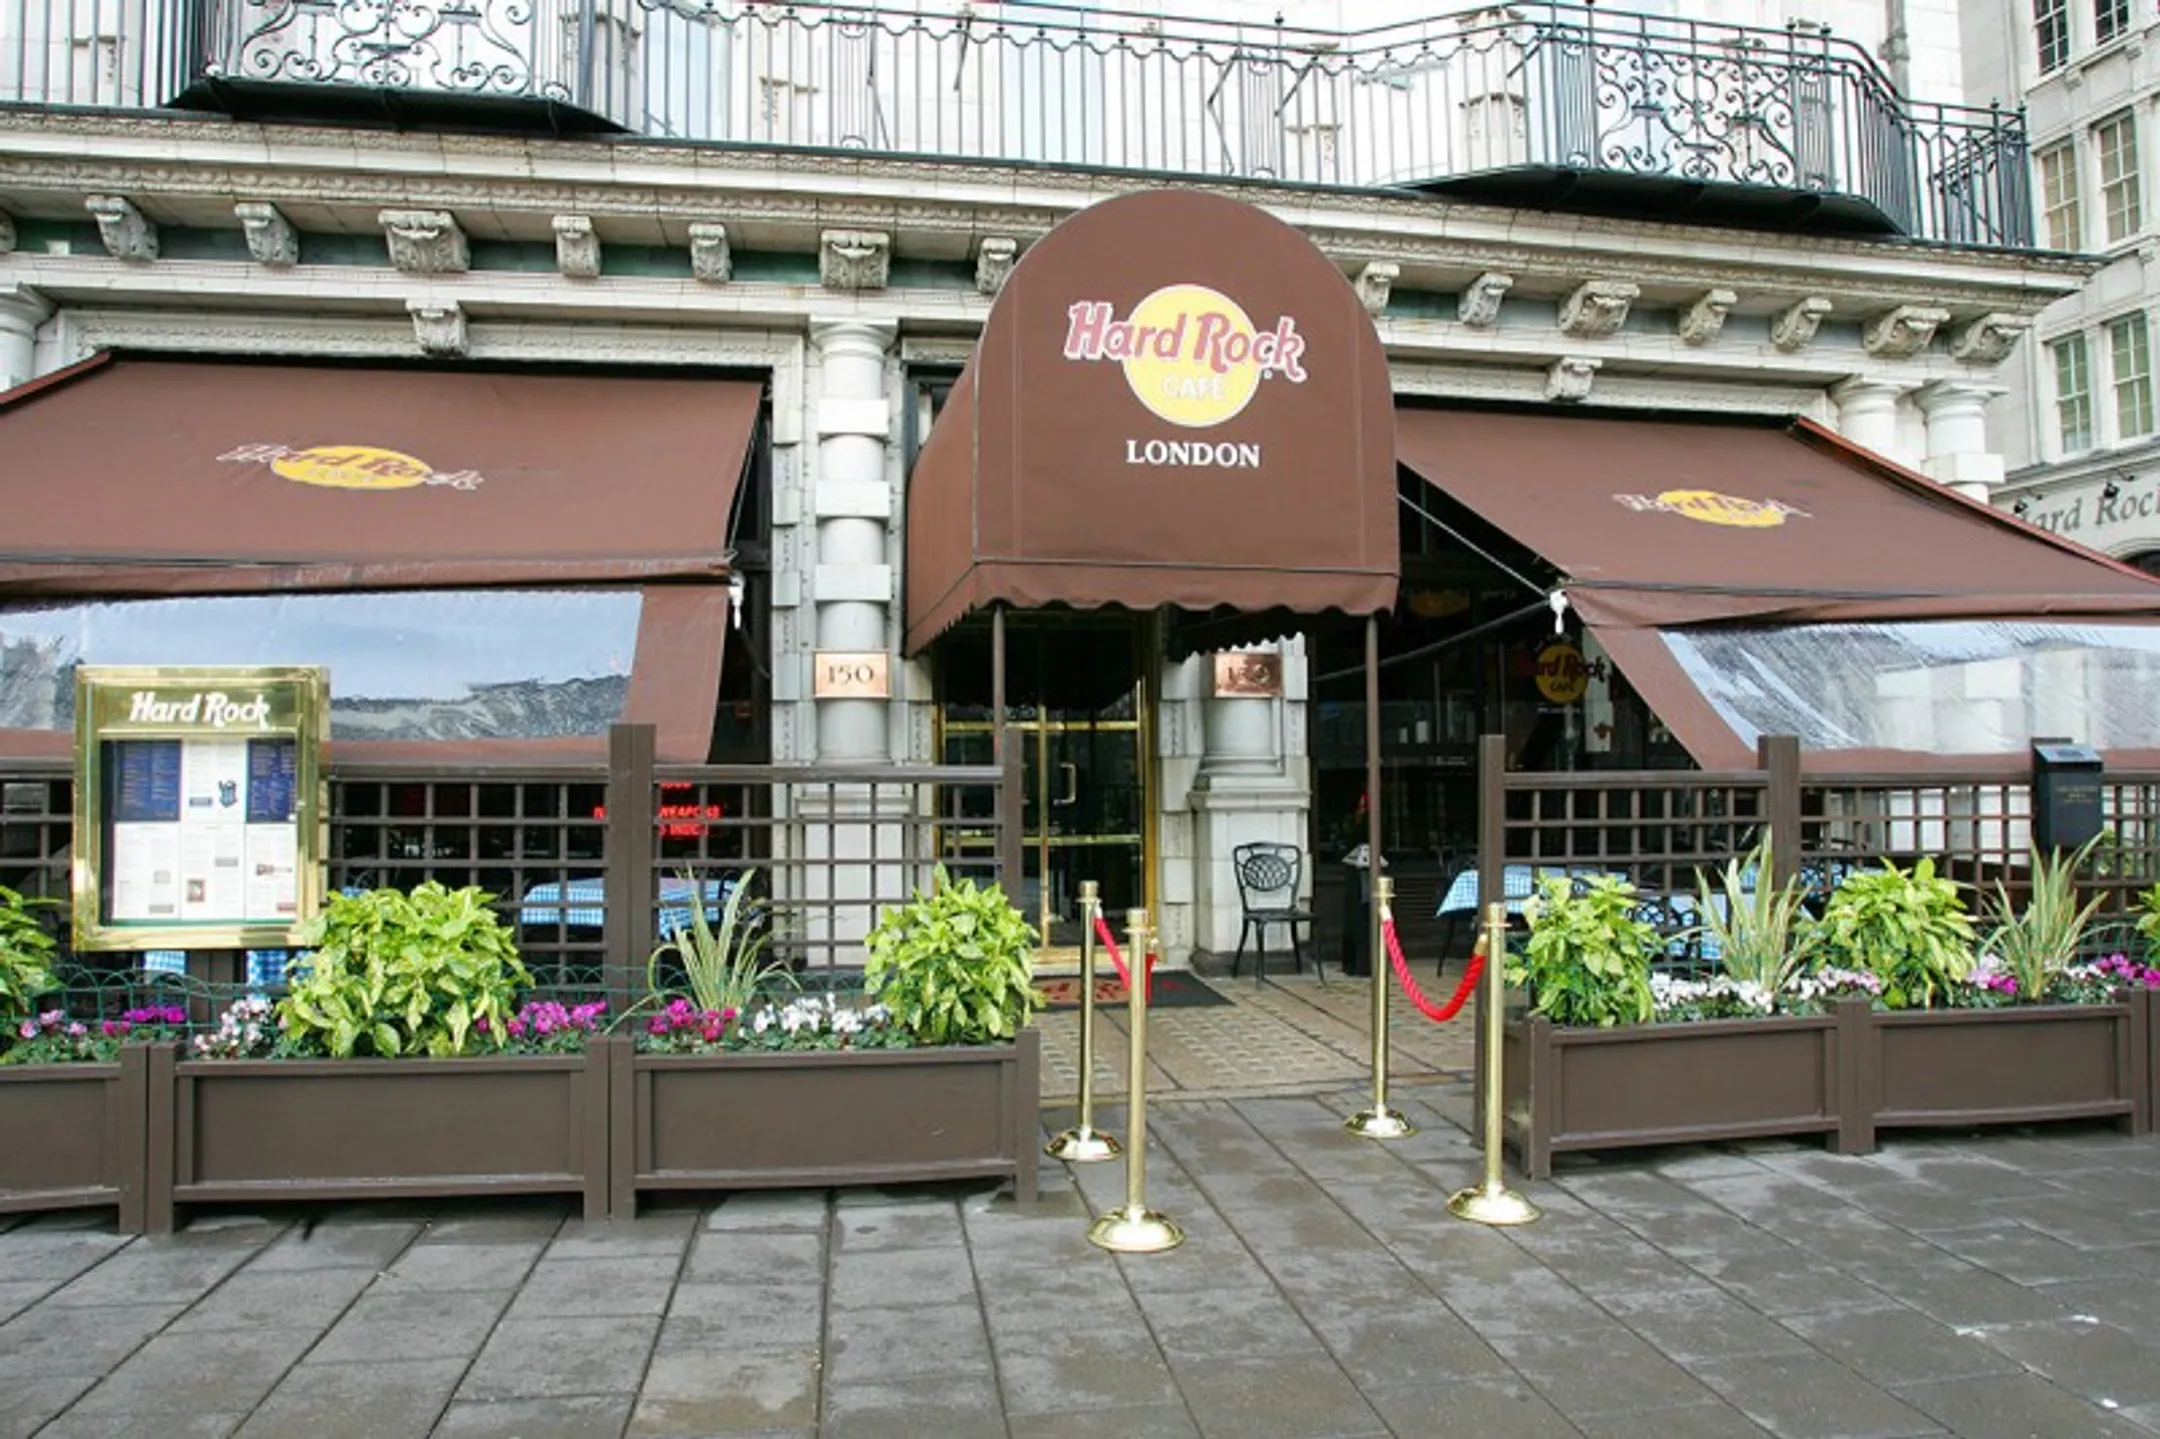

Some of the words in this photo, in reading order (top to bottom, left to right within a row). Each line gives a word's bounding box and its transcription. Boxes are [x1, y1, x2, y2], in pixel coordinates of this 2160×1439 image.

[1064, 300, 1186, 361] Hard
[1191, 312, 1306, 382] Rock
[1126, 440, 1261, 468] LONDON
[828, 664, 874, 686] 150
[129, 691, 201, 723] Hard
[203, 691, 275, 730] Rock
